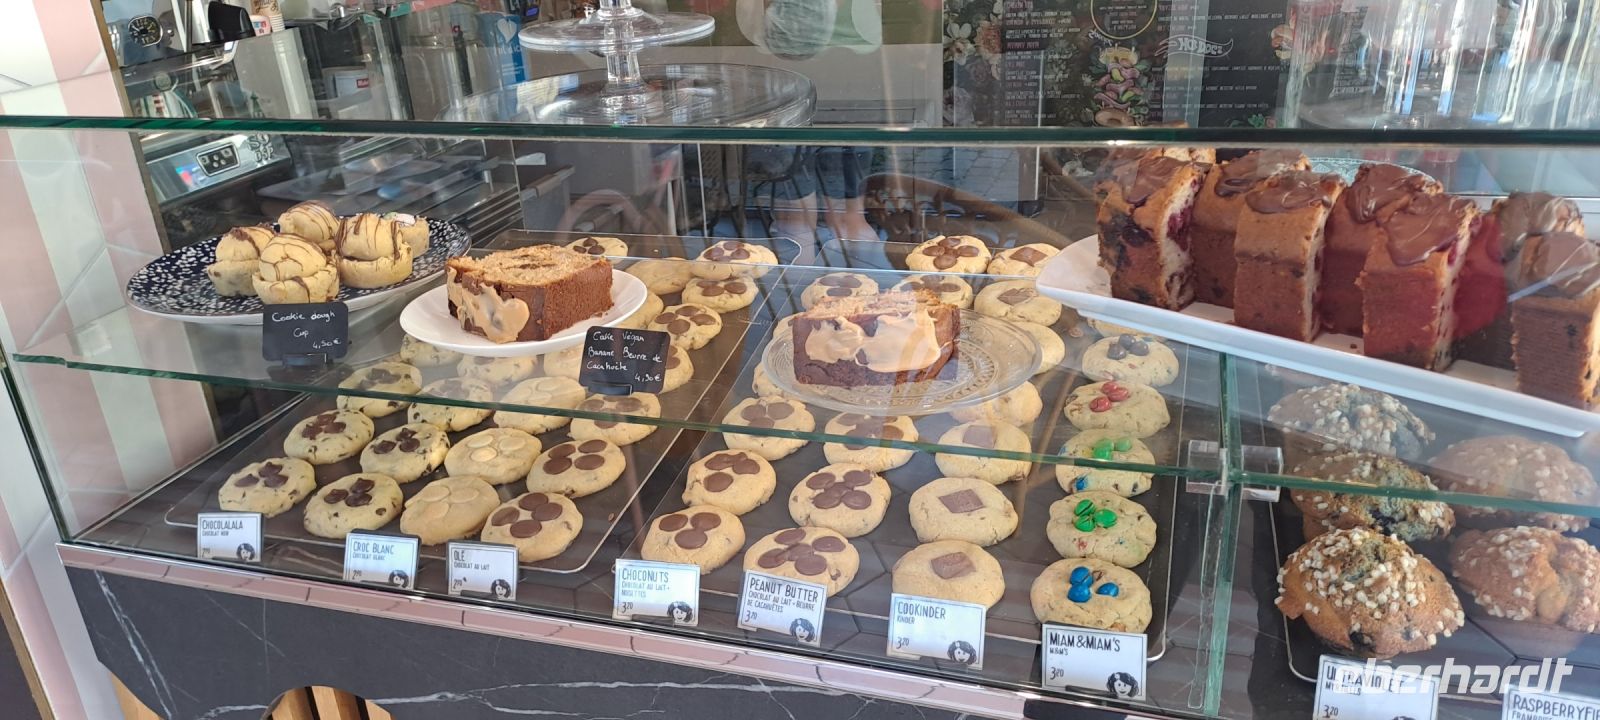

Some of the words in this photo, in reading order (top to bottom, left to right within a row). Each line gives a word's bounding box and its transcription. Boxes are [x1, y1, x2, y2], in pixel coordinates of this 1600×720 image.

[272, 312, 305, 322] Cookie
[311, 310, 335, 322] dough
[293, 328, 309, 338] Cup
[593, 331, 614, 341] Cake
[588, 346, 614, 358] Banane
[623, 346, 647, 361] Beurre
[652, 354, 663, 362] de
[202, 520, 244, 530] CHOCOLALALA
[353, 541, 370, 553] CROC
[373, 543, 395, 555] BLANC
[622, 568, 669, 583] CHOCONUTS
[622, 581, 645, 590] CHOCOLAT
[647, 583, 654, 591] AU
[749, 577, 783, 595] PEANUT
[785, 584, 818, 603] BUTTER
[746, 599, 754, 607] DE
[748, 590, 771, 601] CHOCOLAT
[772, 595, 779, 604] AU
[780, 597, 792, 606] LAIT
[796, 600, 816, 612] BEURRE
[897, 601, 947, 620] COOKINDER
[896, 615, 916, 625] KINDER
